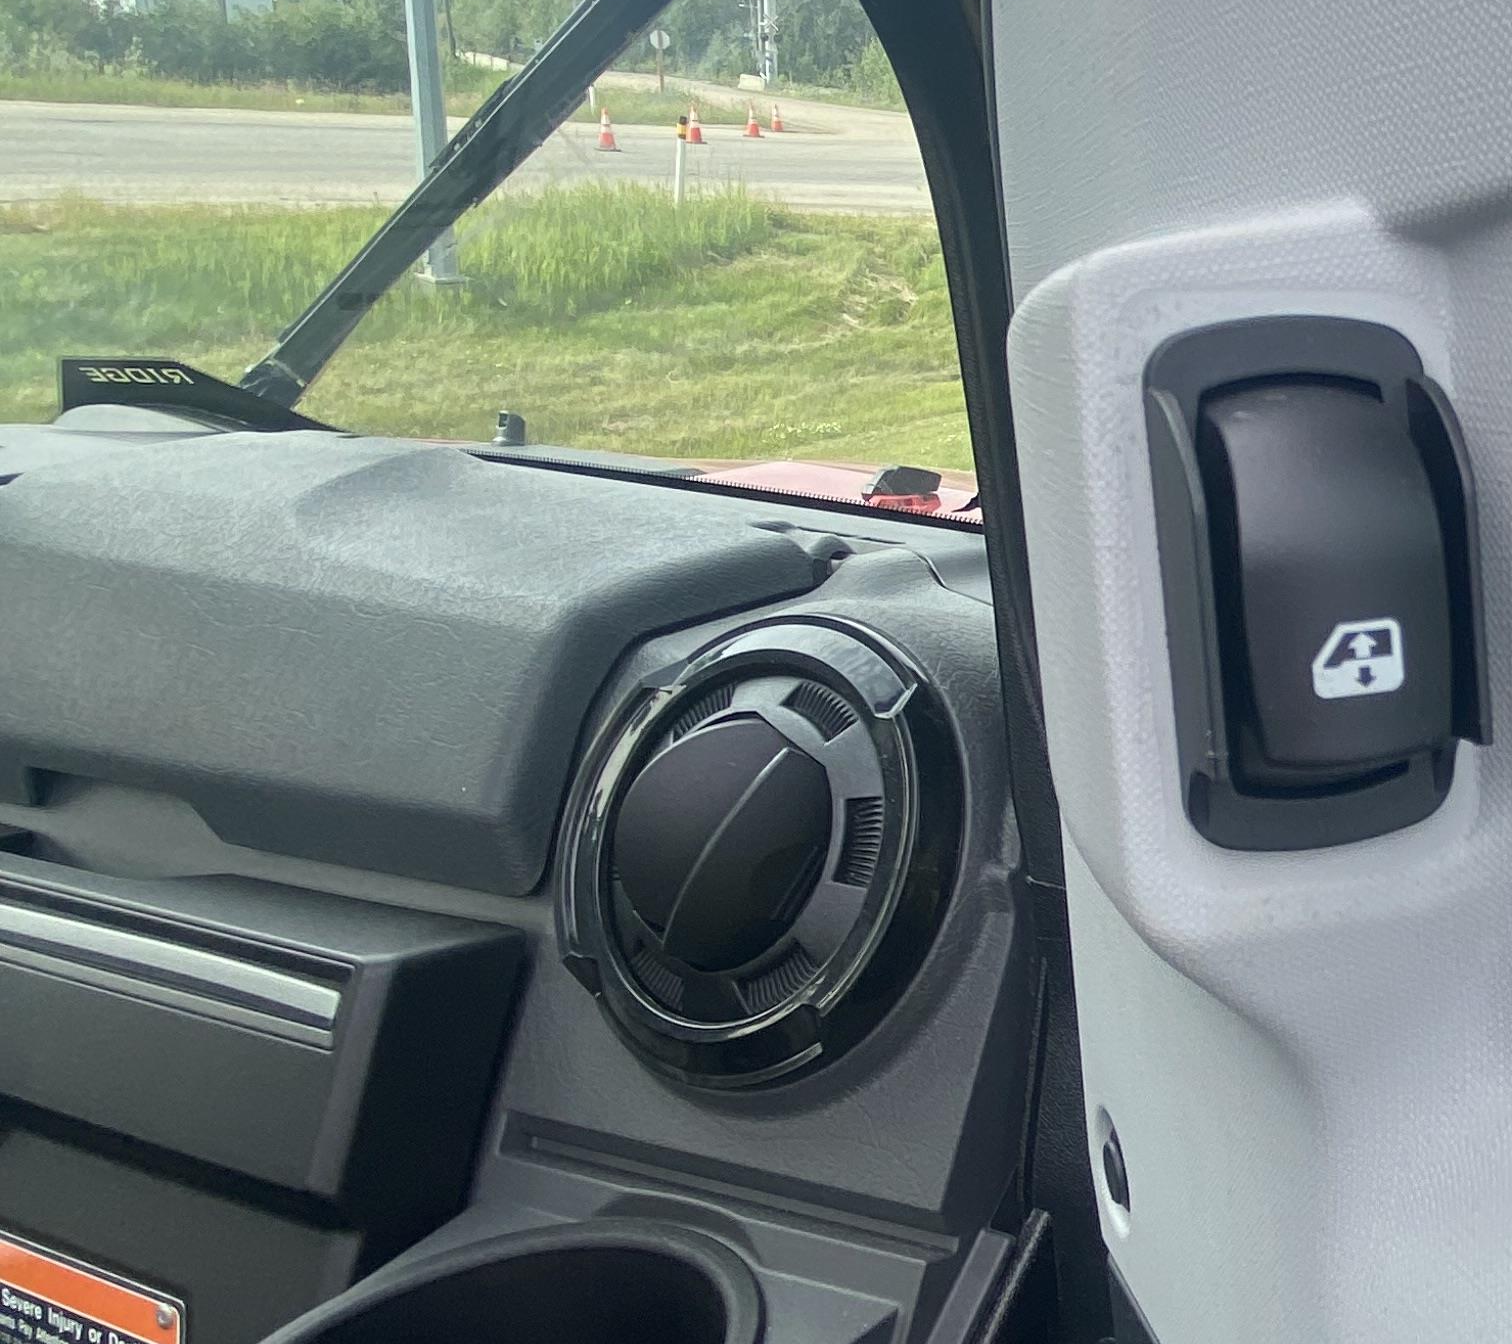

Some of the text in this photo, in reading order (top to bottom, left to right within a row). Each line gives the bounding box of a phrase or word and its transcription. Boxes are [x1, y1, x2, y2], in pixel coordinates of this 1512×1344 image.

[1, 1288, 42, 1320] Severe
[48, 1307, 83, 1341] Injury
[88, 1328, 102, 1344] or
